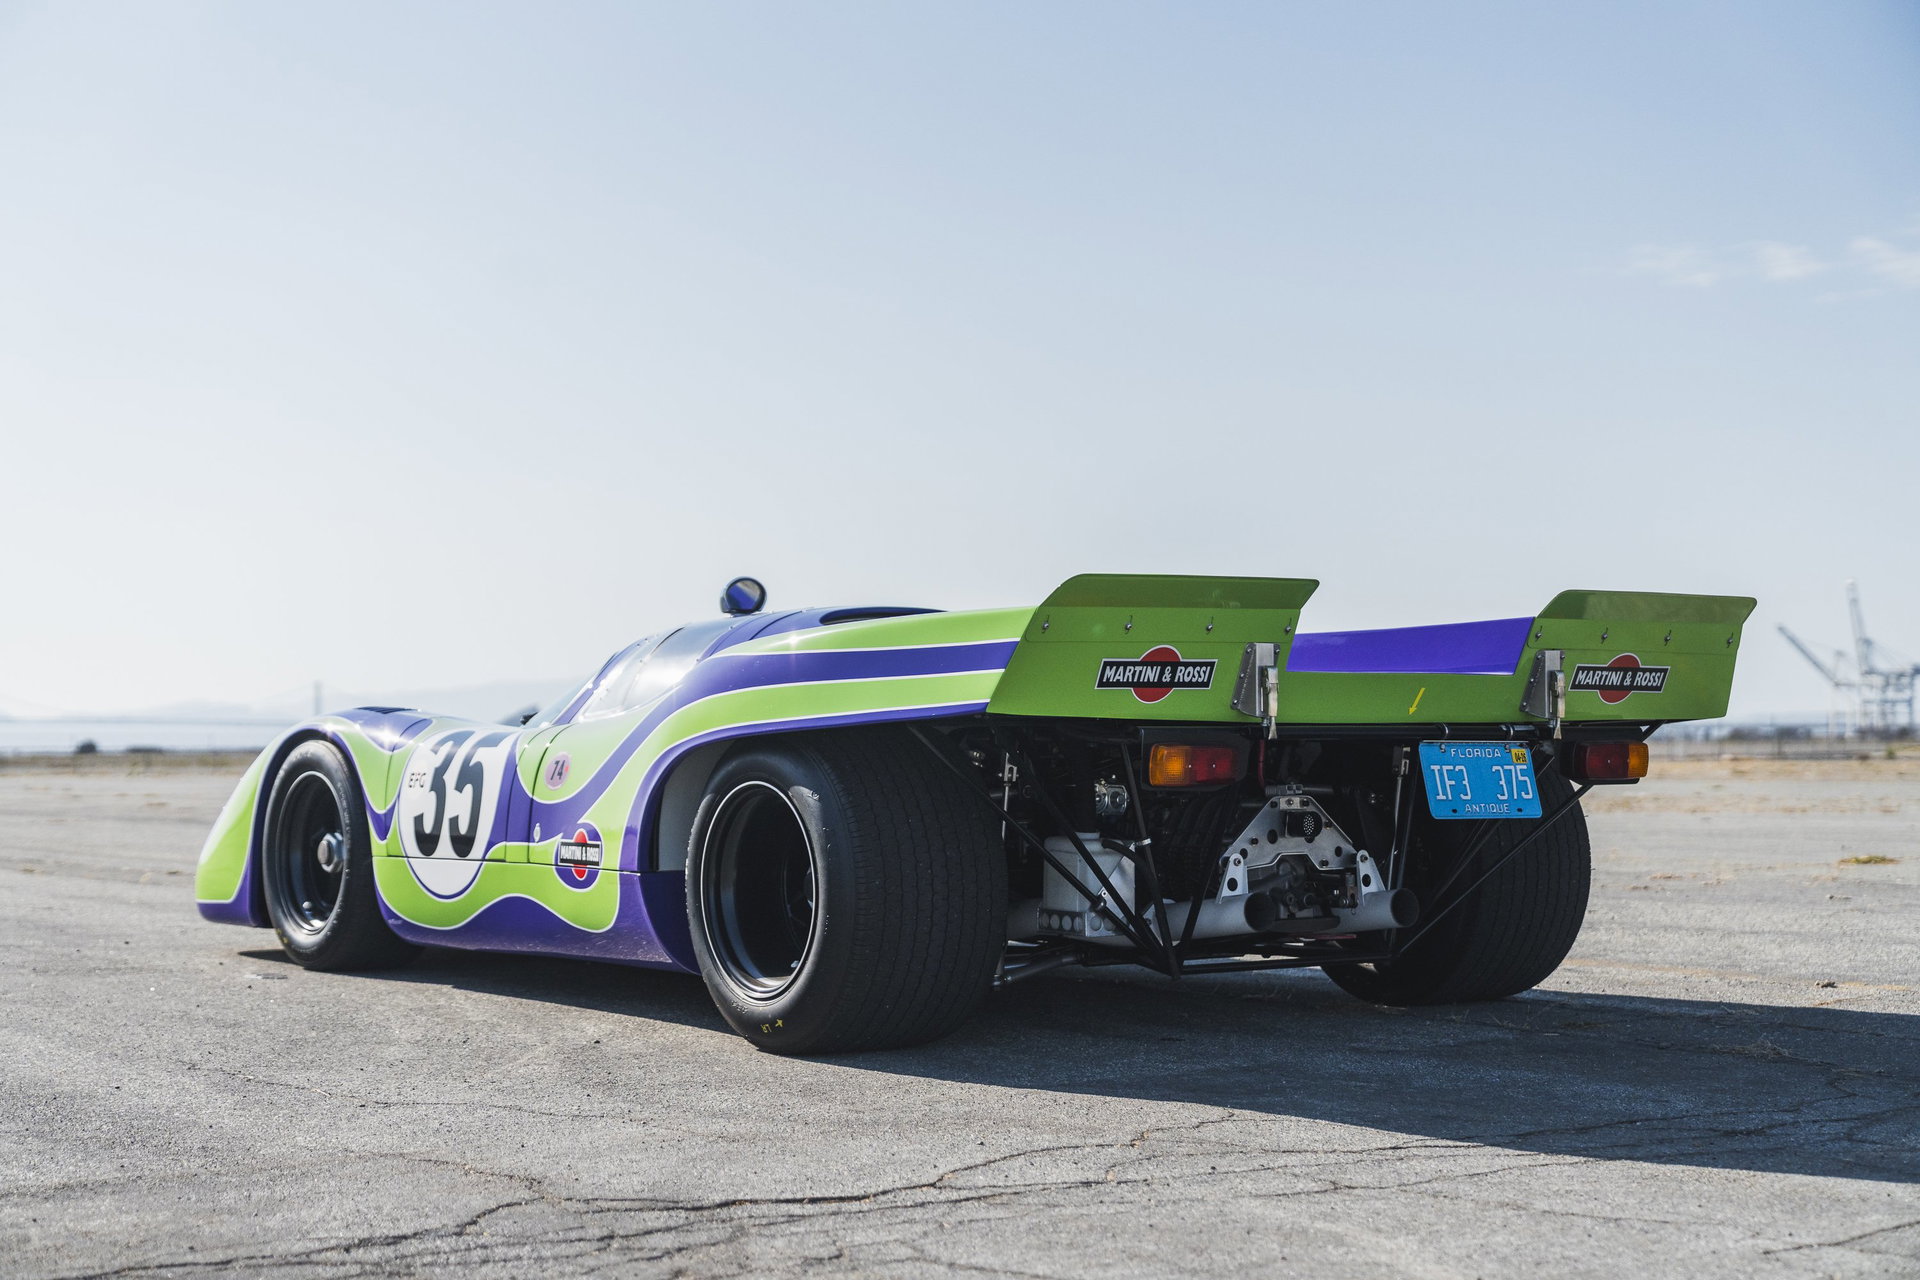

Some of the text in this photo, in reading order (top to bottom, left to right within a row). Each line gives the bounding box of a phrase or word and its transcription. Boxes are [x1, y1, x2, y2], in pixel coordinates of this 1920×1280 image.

[1103, 665, 1210, 683] MARTINI & ROSSI
[1575, 670, 1664, 687] MARTINI & ROSSI
[1451, 748, 1501, 758] FLORIDA
[1430, 765, 1533, 800] IF3 375
[413, 729, 514, 859] 35
[1465, 803, 1511, 814] ANTIQUE
[560, 844, 599, 862] MARTINI & ROSSI
